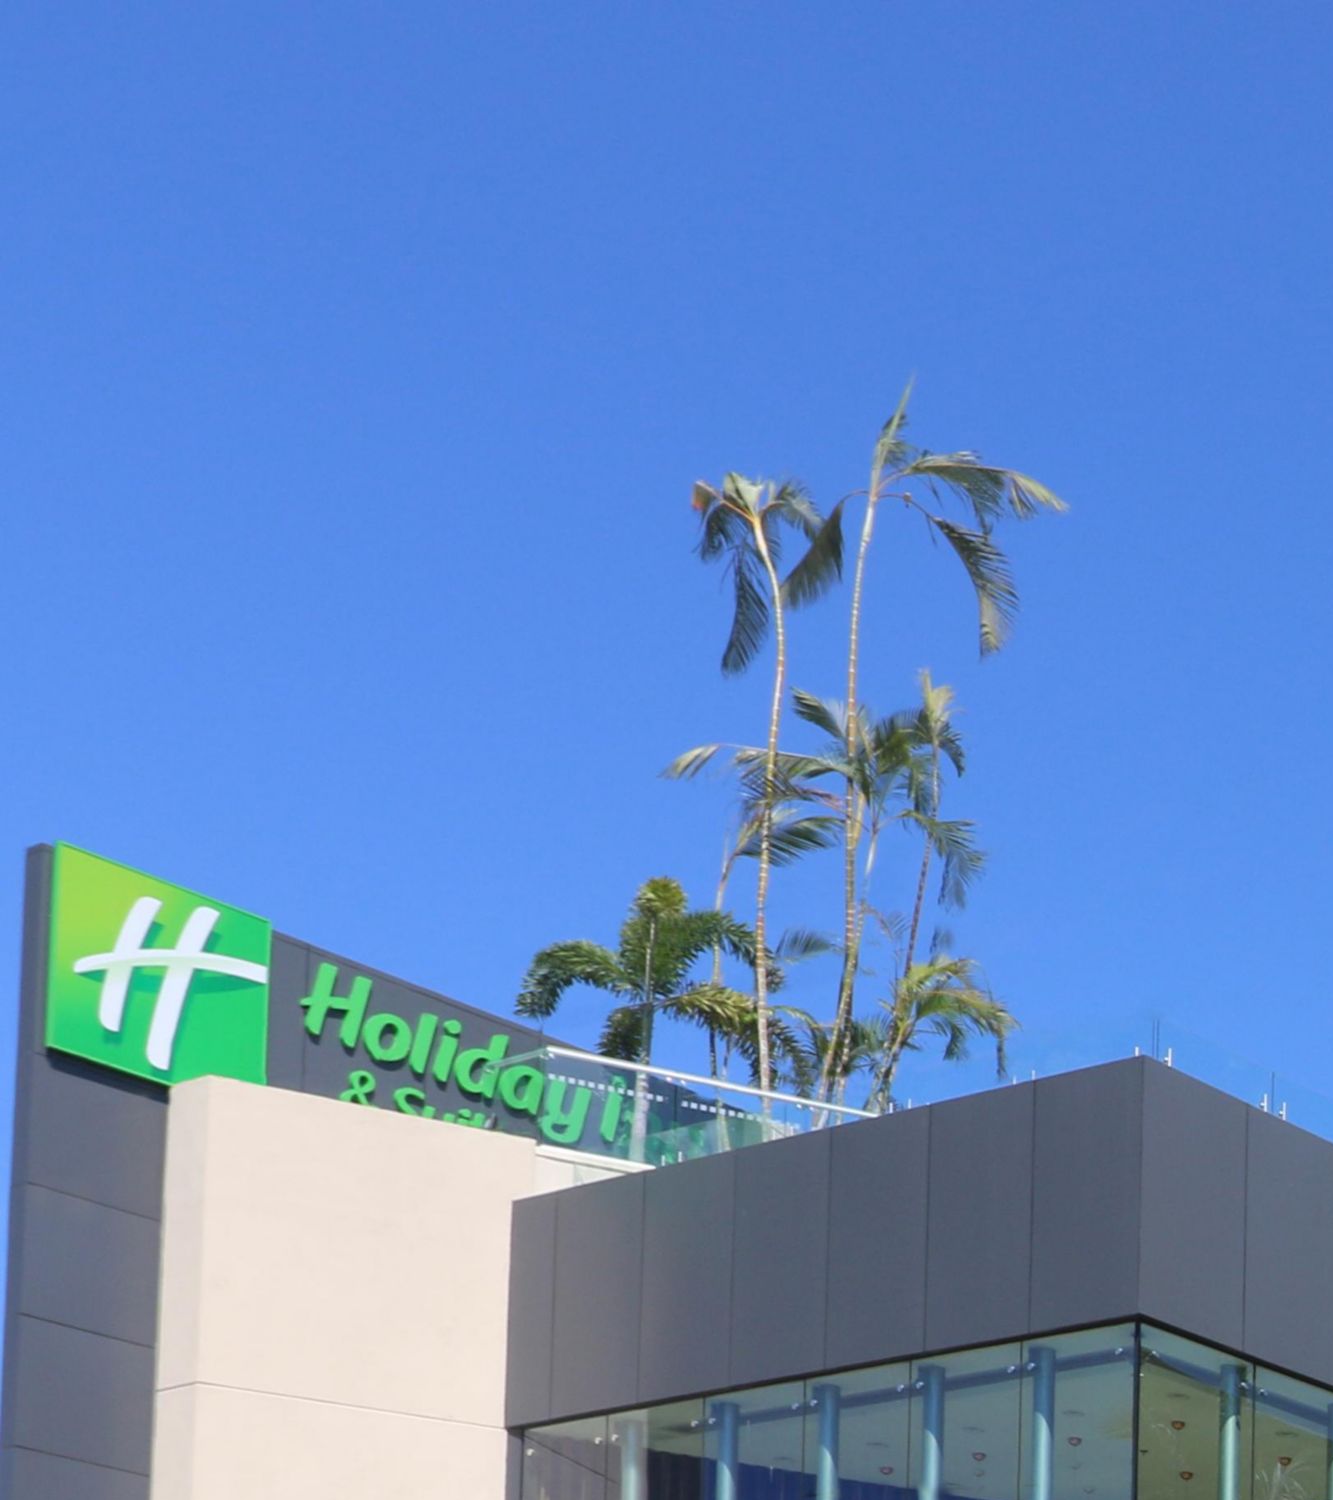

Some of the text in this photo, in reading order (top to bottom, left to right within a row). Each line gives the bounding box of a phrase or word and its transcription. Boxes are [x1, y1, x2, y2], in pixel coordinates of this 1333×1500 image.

[73, 896, 268, 1071] H
[301, 963, 592, 1144] Holiday
[339, 1070, 376, 1106] &
